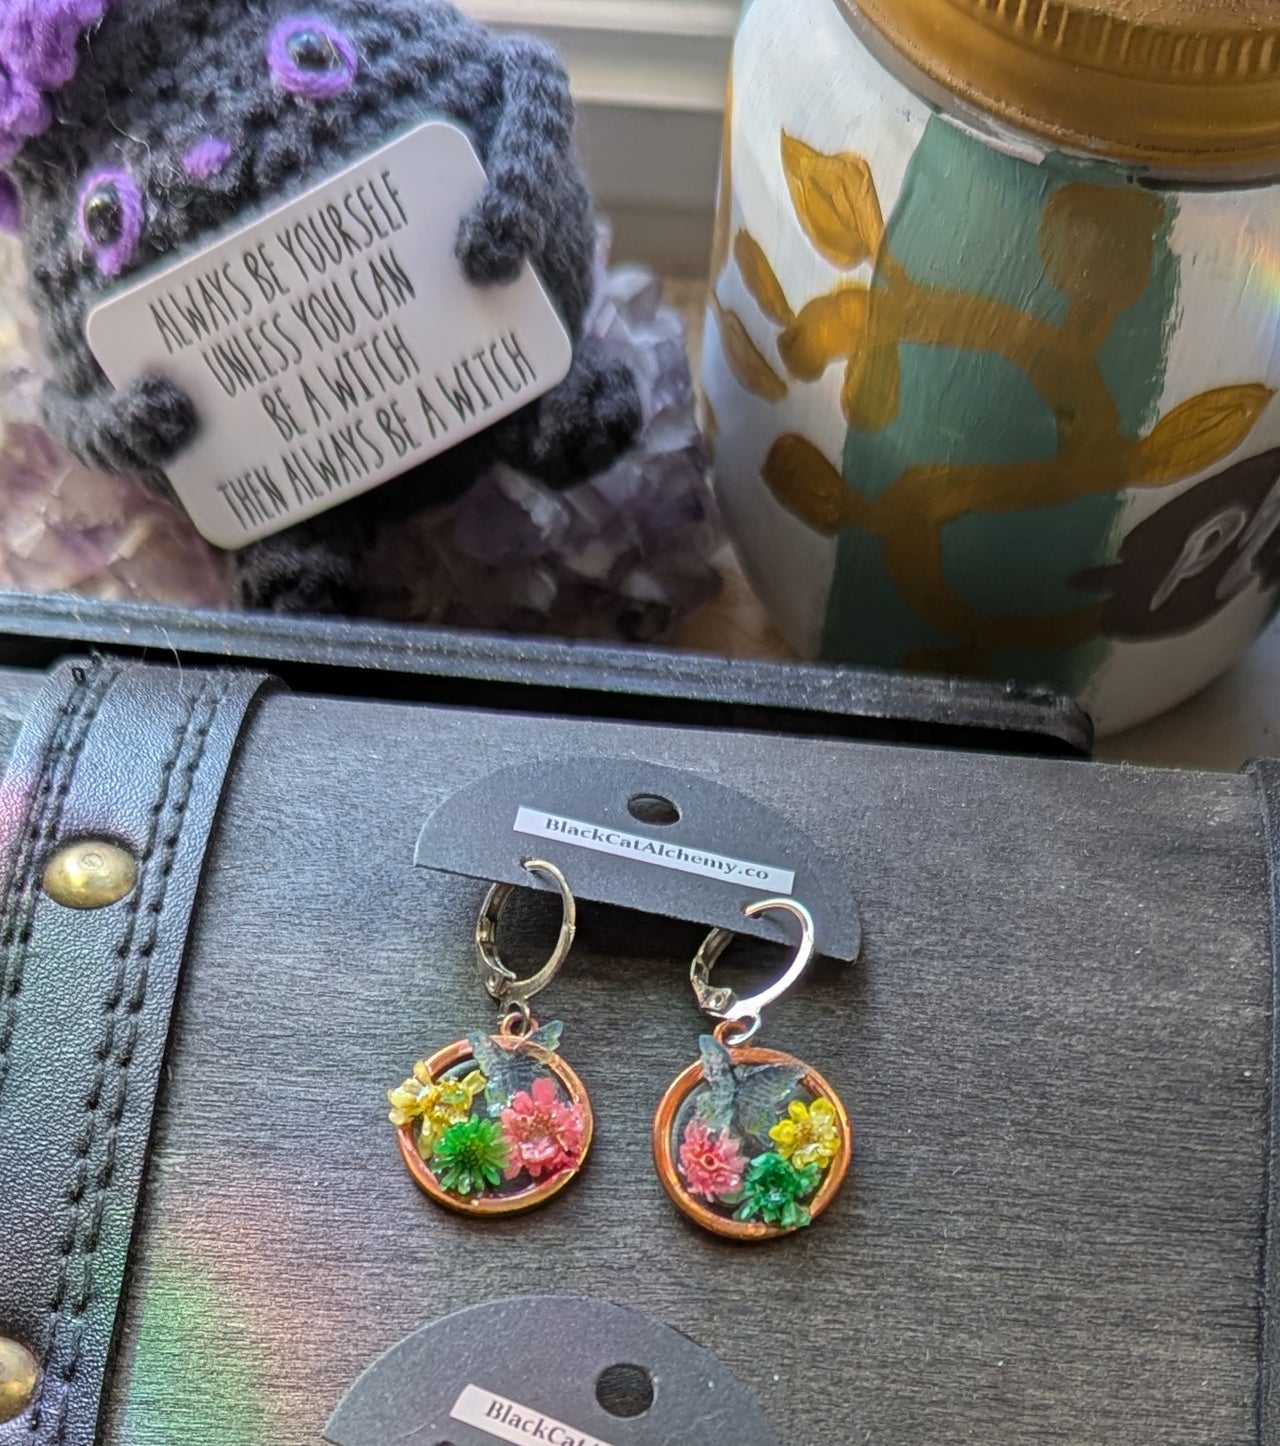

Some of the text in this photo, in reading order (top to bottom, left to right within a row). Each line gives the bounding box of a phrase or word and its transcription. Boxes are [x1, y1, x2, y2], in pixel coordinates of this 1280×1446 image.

[149, 172, 409, 354] ALWAYS BE YOURSELF
[200, 248, 417, 398] UNLESS YOU CAN
[217, 330, 537, 531] THEN ALWAYS BE A WITCH
[261, 325, 420, 443] BE A WITCH
[545, 818, 769, 880] BlackCatAlchemy.co
